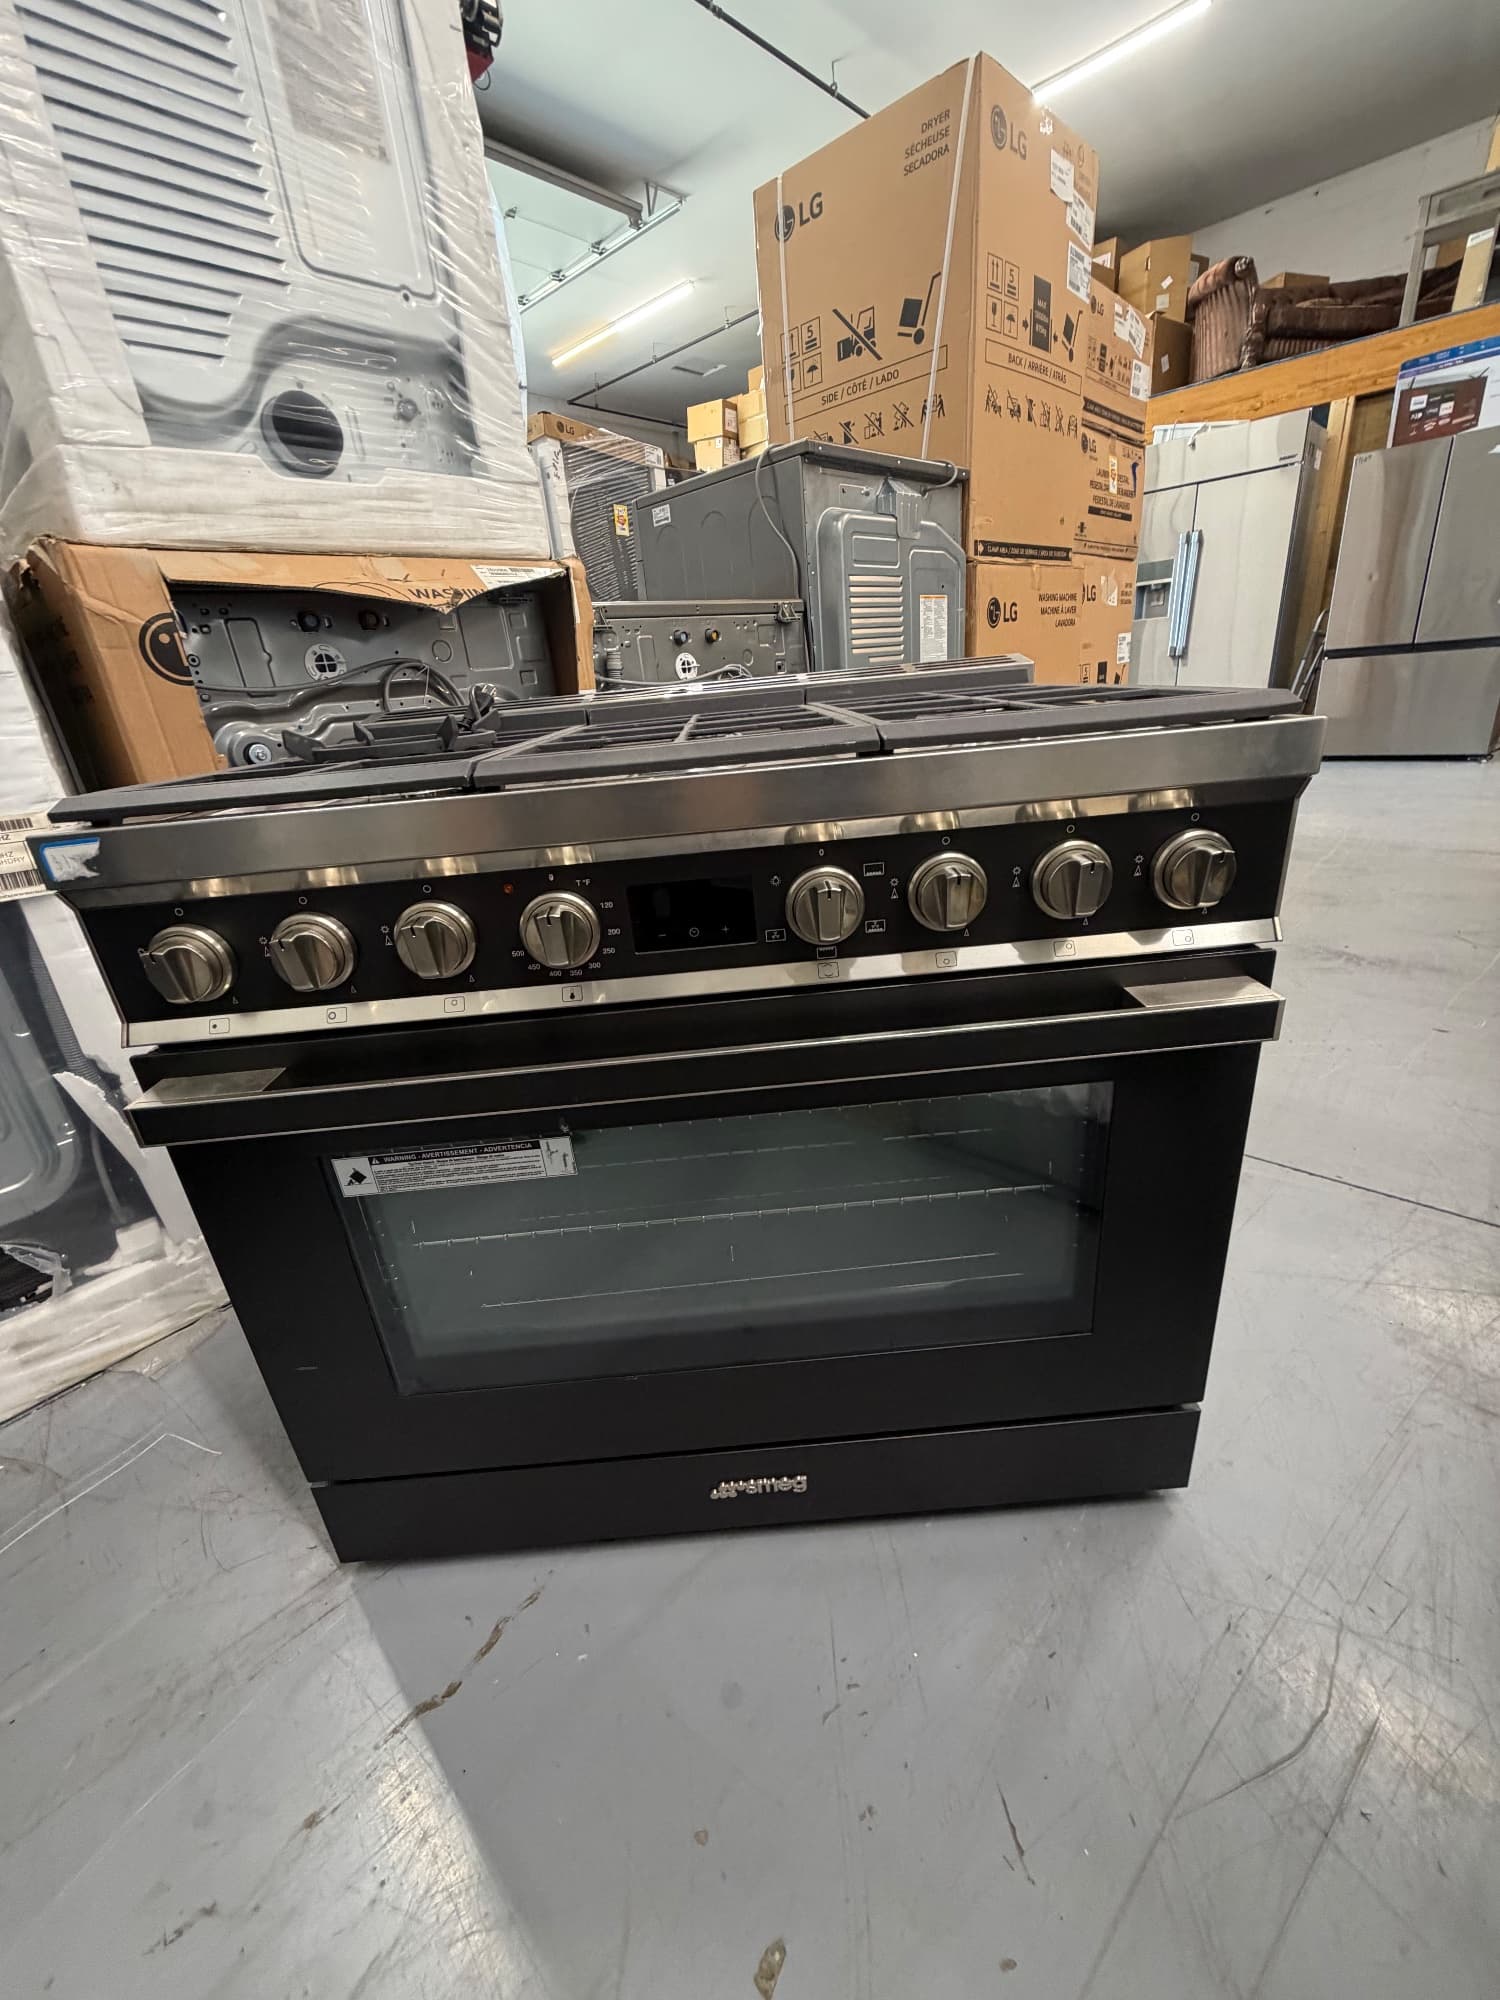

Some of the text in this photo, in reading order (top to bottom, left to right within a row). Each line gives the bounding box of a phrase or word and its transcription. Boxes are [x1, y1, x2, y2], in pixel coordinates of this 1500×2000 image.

[921, 109, 950, 134] DRYER
[1010, 121, 1027, 160] LG
[904, 144, 950, 176] SECADORA
[799, 191, 823, 227] LG
[1097, 301, 1104, 316] LG
[807, 325, 814, 338] 5
[1008, 352, 1023, 367] BACK
[822, 391, 838, 405] SIDE
[846, 378, 867, 396] CÔTÉ
[875, 369, 899, 385] LADO
[565, 423, 575, 435] LG
[1089, 438, 1097, 453] LG
[1087, 585, 1096, 602] LG
[1003, 602, 1017, 623] LG
[384, 1154, 417, 1162] WARNING
[422, 1147, 478, 1159] AVERTISSEMENT
[484, 1142, 533, 1152] ADVERTENCIA
[746, 1475, 807, 1494] smeg
